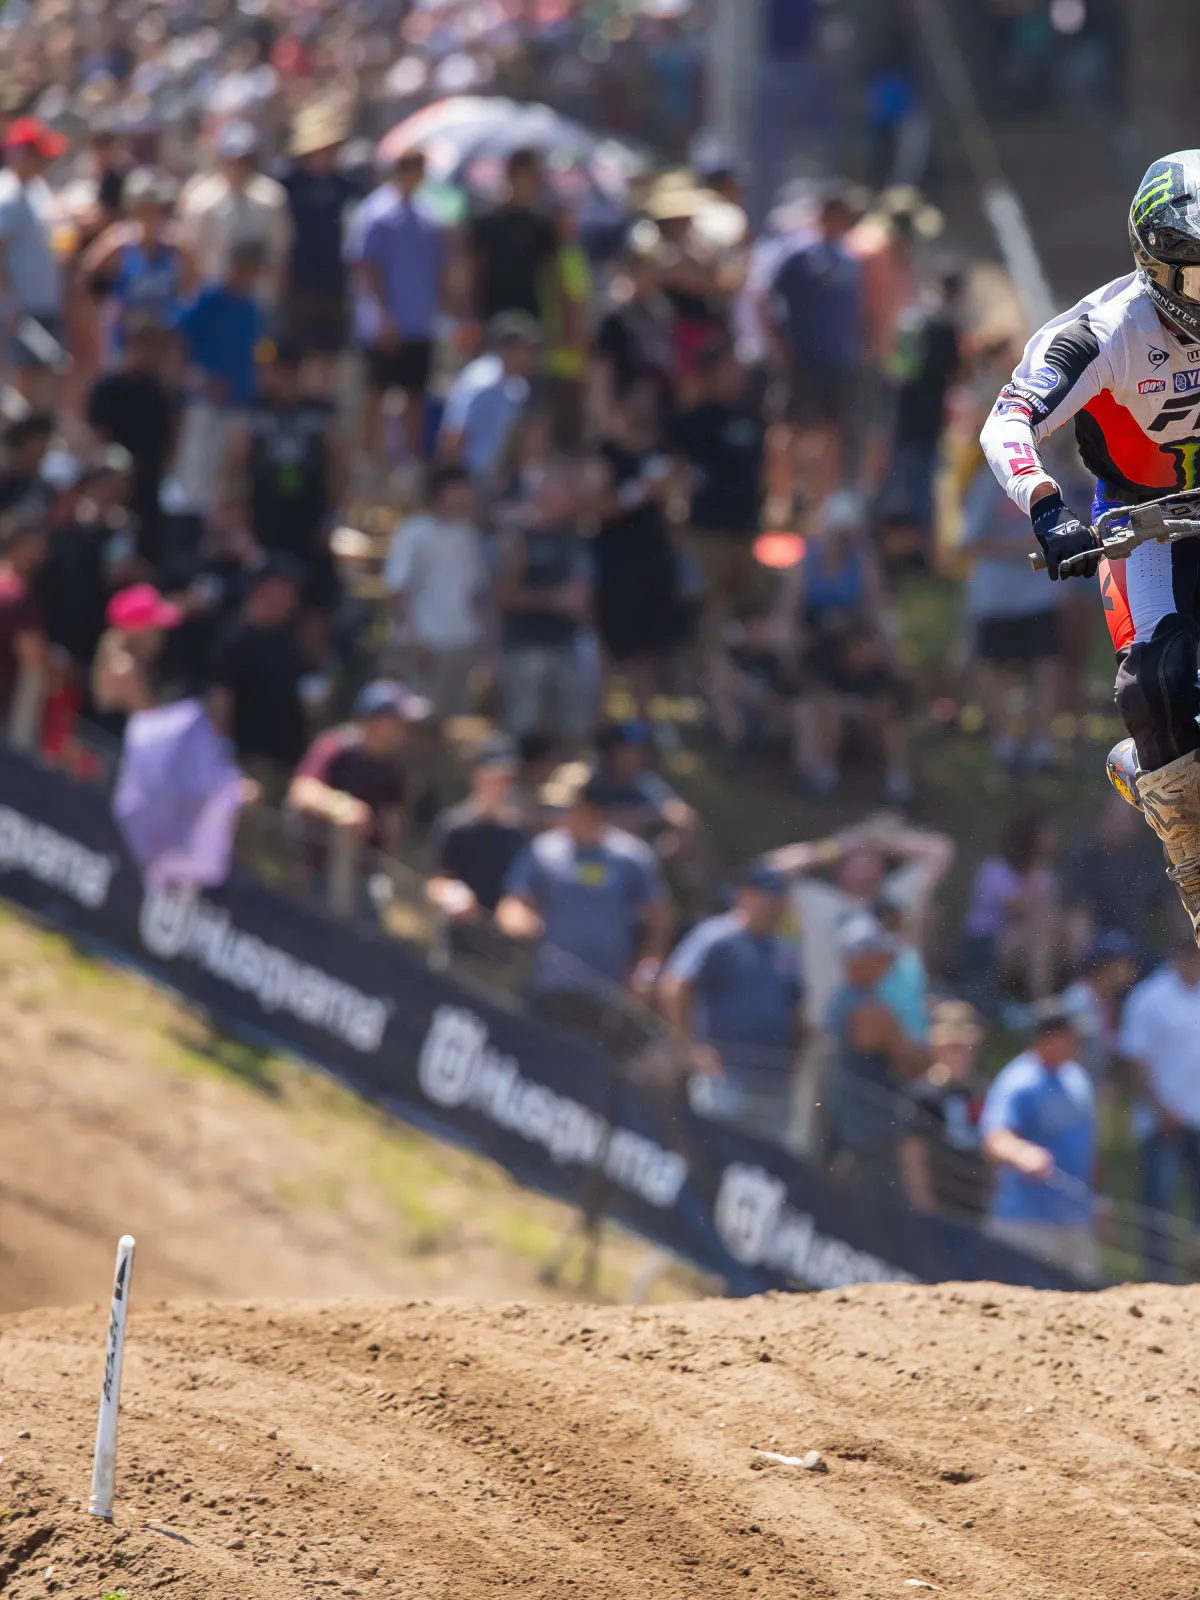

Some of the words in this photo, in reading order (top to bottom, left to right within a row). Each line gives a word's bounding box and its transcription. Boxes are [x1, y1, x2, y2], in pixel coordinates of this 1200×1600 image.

[1152, 288, 1198, 327] ONSTER
[1139, 381, 1164, 394] 100%
[190, 900, 390, 1053] Husqvarna
